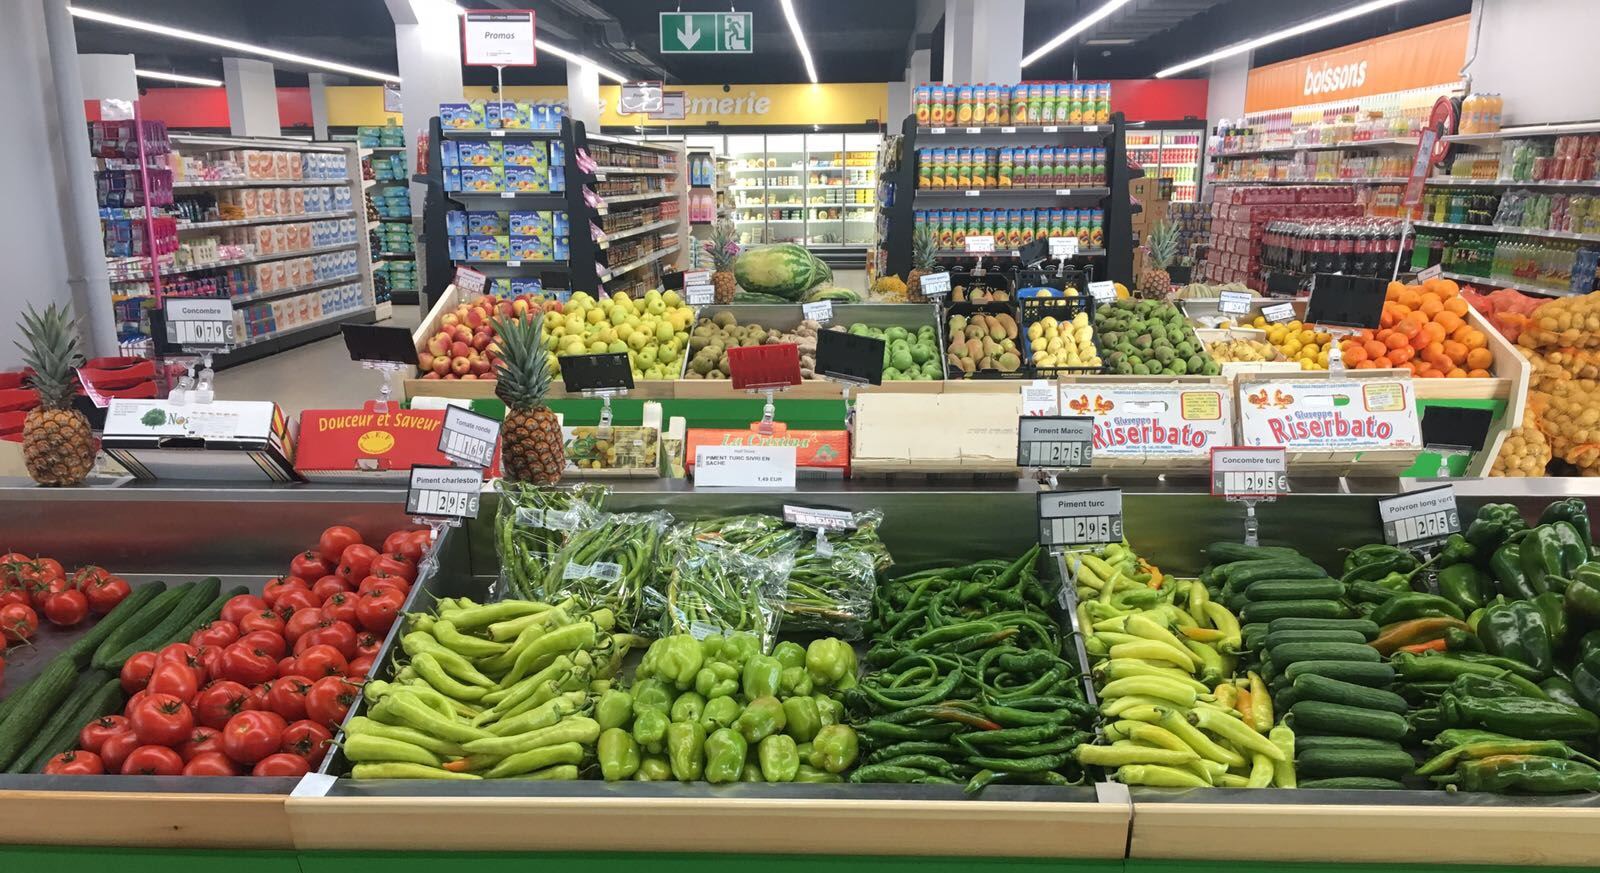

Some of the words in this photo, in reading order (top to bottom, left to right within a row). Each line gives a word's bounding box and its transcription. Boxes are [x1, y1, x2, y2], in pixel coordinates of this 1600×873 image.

[484, 31, 515, 40] Promos
[1304, 61, 1367, 96] boissons
[319, 413, 373, 432] Douceur
[377, 413, 390, 427] et
[393, 413, 441, 432] Saveur
[455, 417, 474, 431] Tomate
[474, 423, 491, 434] ronde
[1033, 427, 1059, 435] Piment
[1060, 426, 1083, 435] Maroc
[1267, 411, 1393, 445] Riserbato
[1092, 417, 1209, 449] Riserbato
[1222, 457, 1264, 465] Concombre
[416, 476, 440, 486] Piment
[441, 476, 478, 485] charleston
[1058, 499, 1087, 509] Piment
[1088, 499, 1105, 508] turc
[1389, 502, 1418, 514] Poivron
[1419, 499, 1437, 513] long
[1437, 495, 1453, 507] vert
